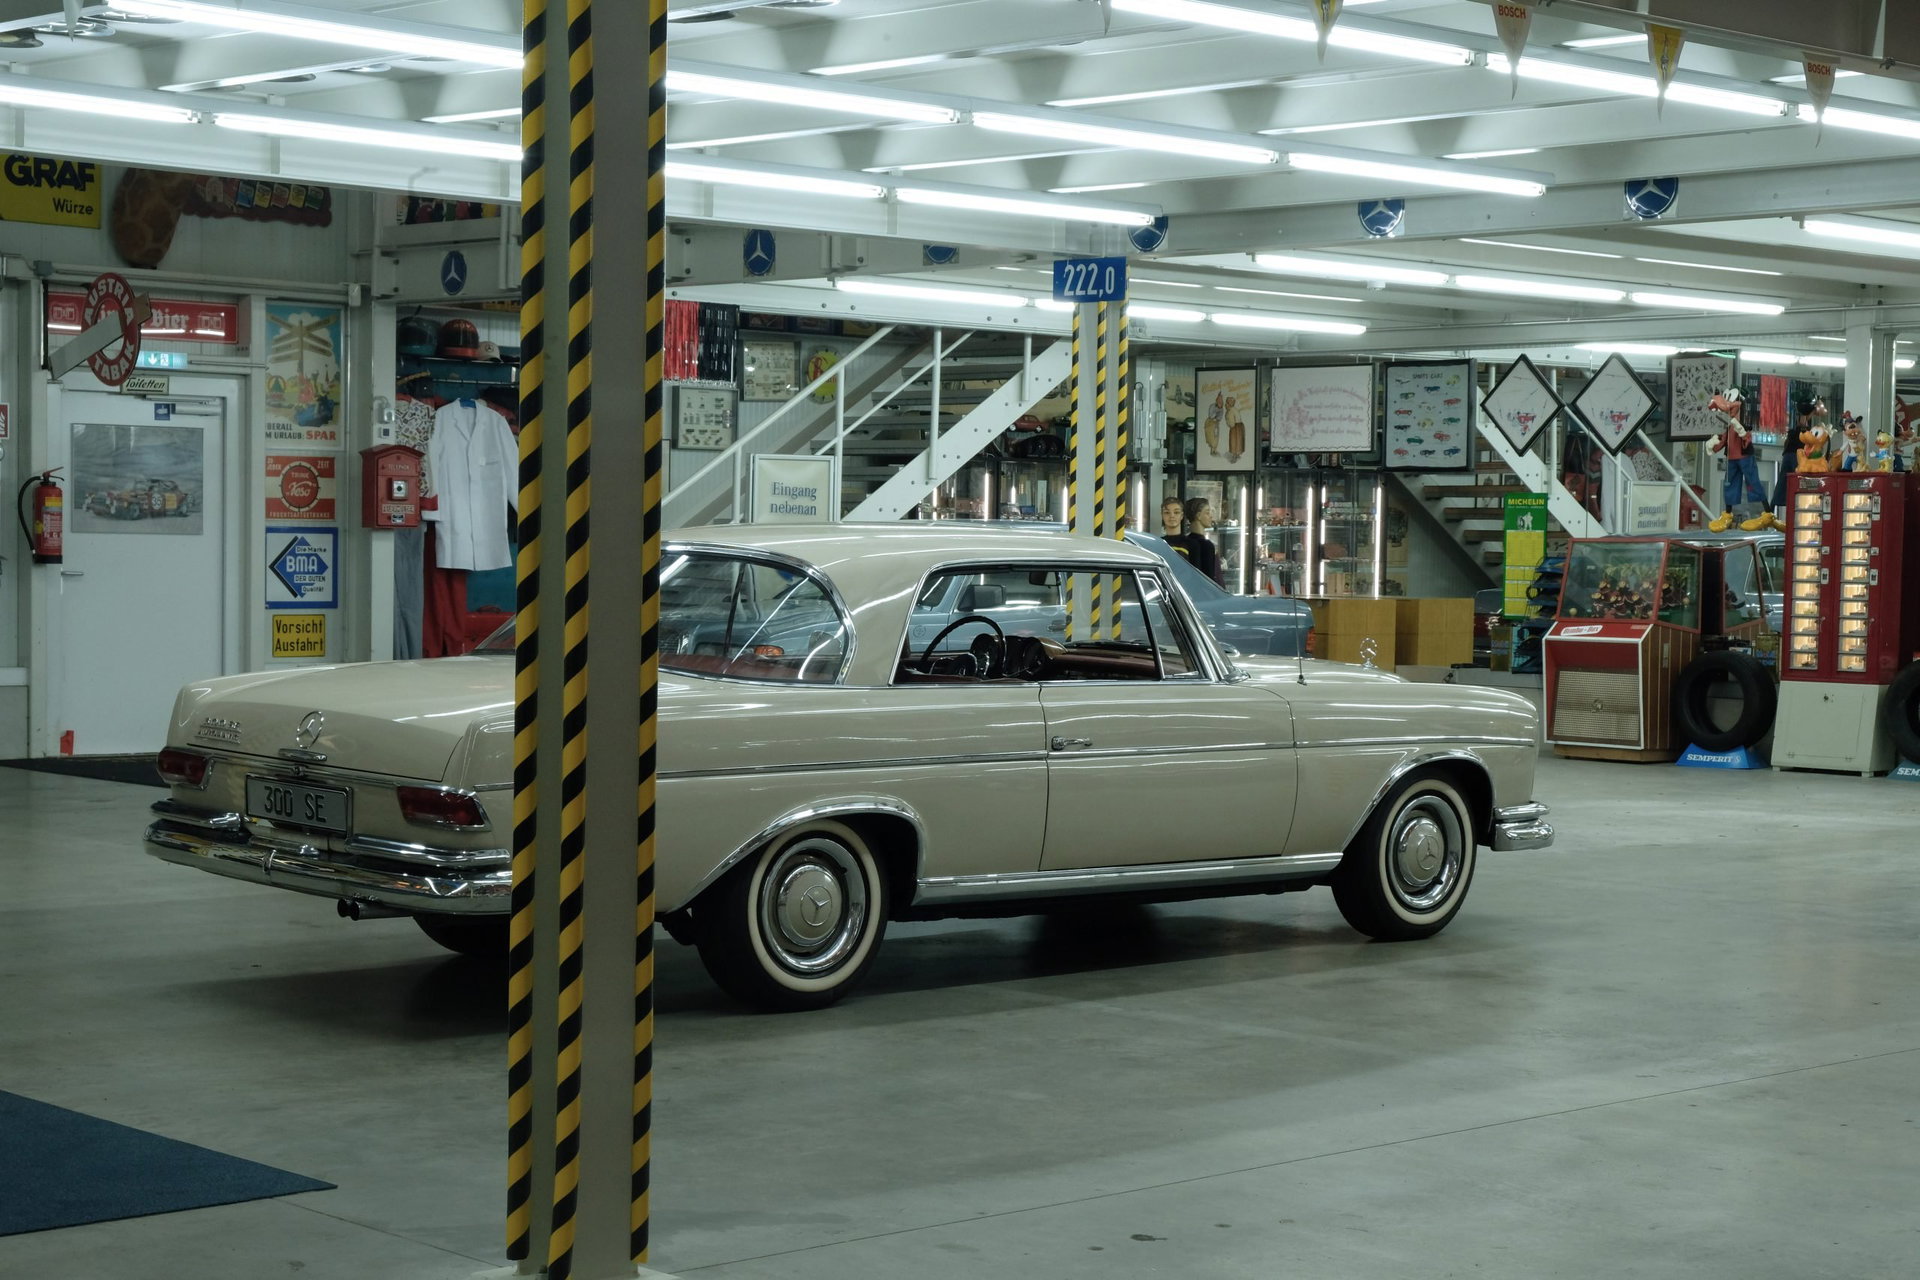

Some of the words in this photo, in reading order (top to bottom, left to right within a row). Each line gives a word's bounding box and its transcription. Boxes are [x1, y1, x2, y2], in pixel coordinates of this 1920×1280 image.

[1497, 4, 1527, 19] BOSCH
[1807, 62, 1831, 76] BOSCH
[4, 154, 95, 192] GRAF
[52, 197, 94, 215] Würze
[151, 308, 190, 330] Bier
[93, 342, 135, 381] TABAK
[125, 376, 166, 389] Toiletten
[306, 430, 337, 441] SPAR
[772, 481, 817, 501] Eingang
[769, 501, 817, 516] nebenan
[307, 546, 327, 554] Marke
[286, 555, 318, 573] BMA
[302, 585, 324, 593] Qualität
[275, 619, 323, 634] Vorsicht
[274, 638, 323, 652] Ausfahrt
[1686, 753, 1732, 763] SEMPERIT
[264, 785, 293, 817] 300
[304, 792, 327, 823] SE
